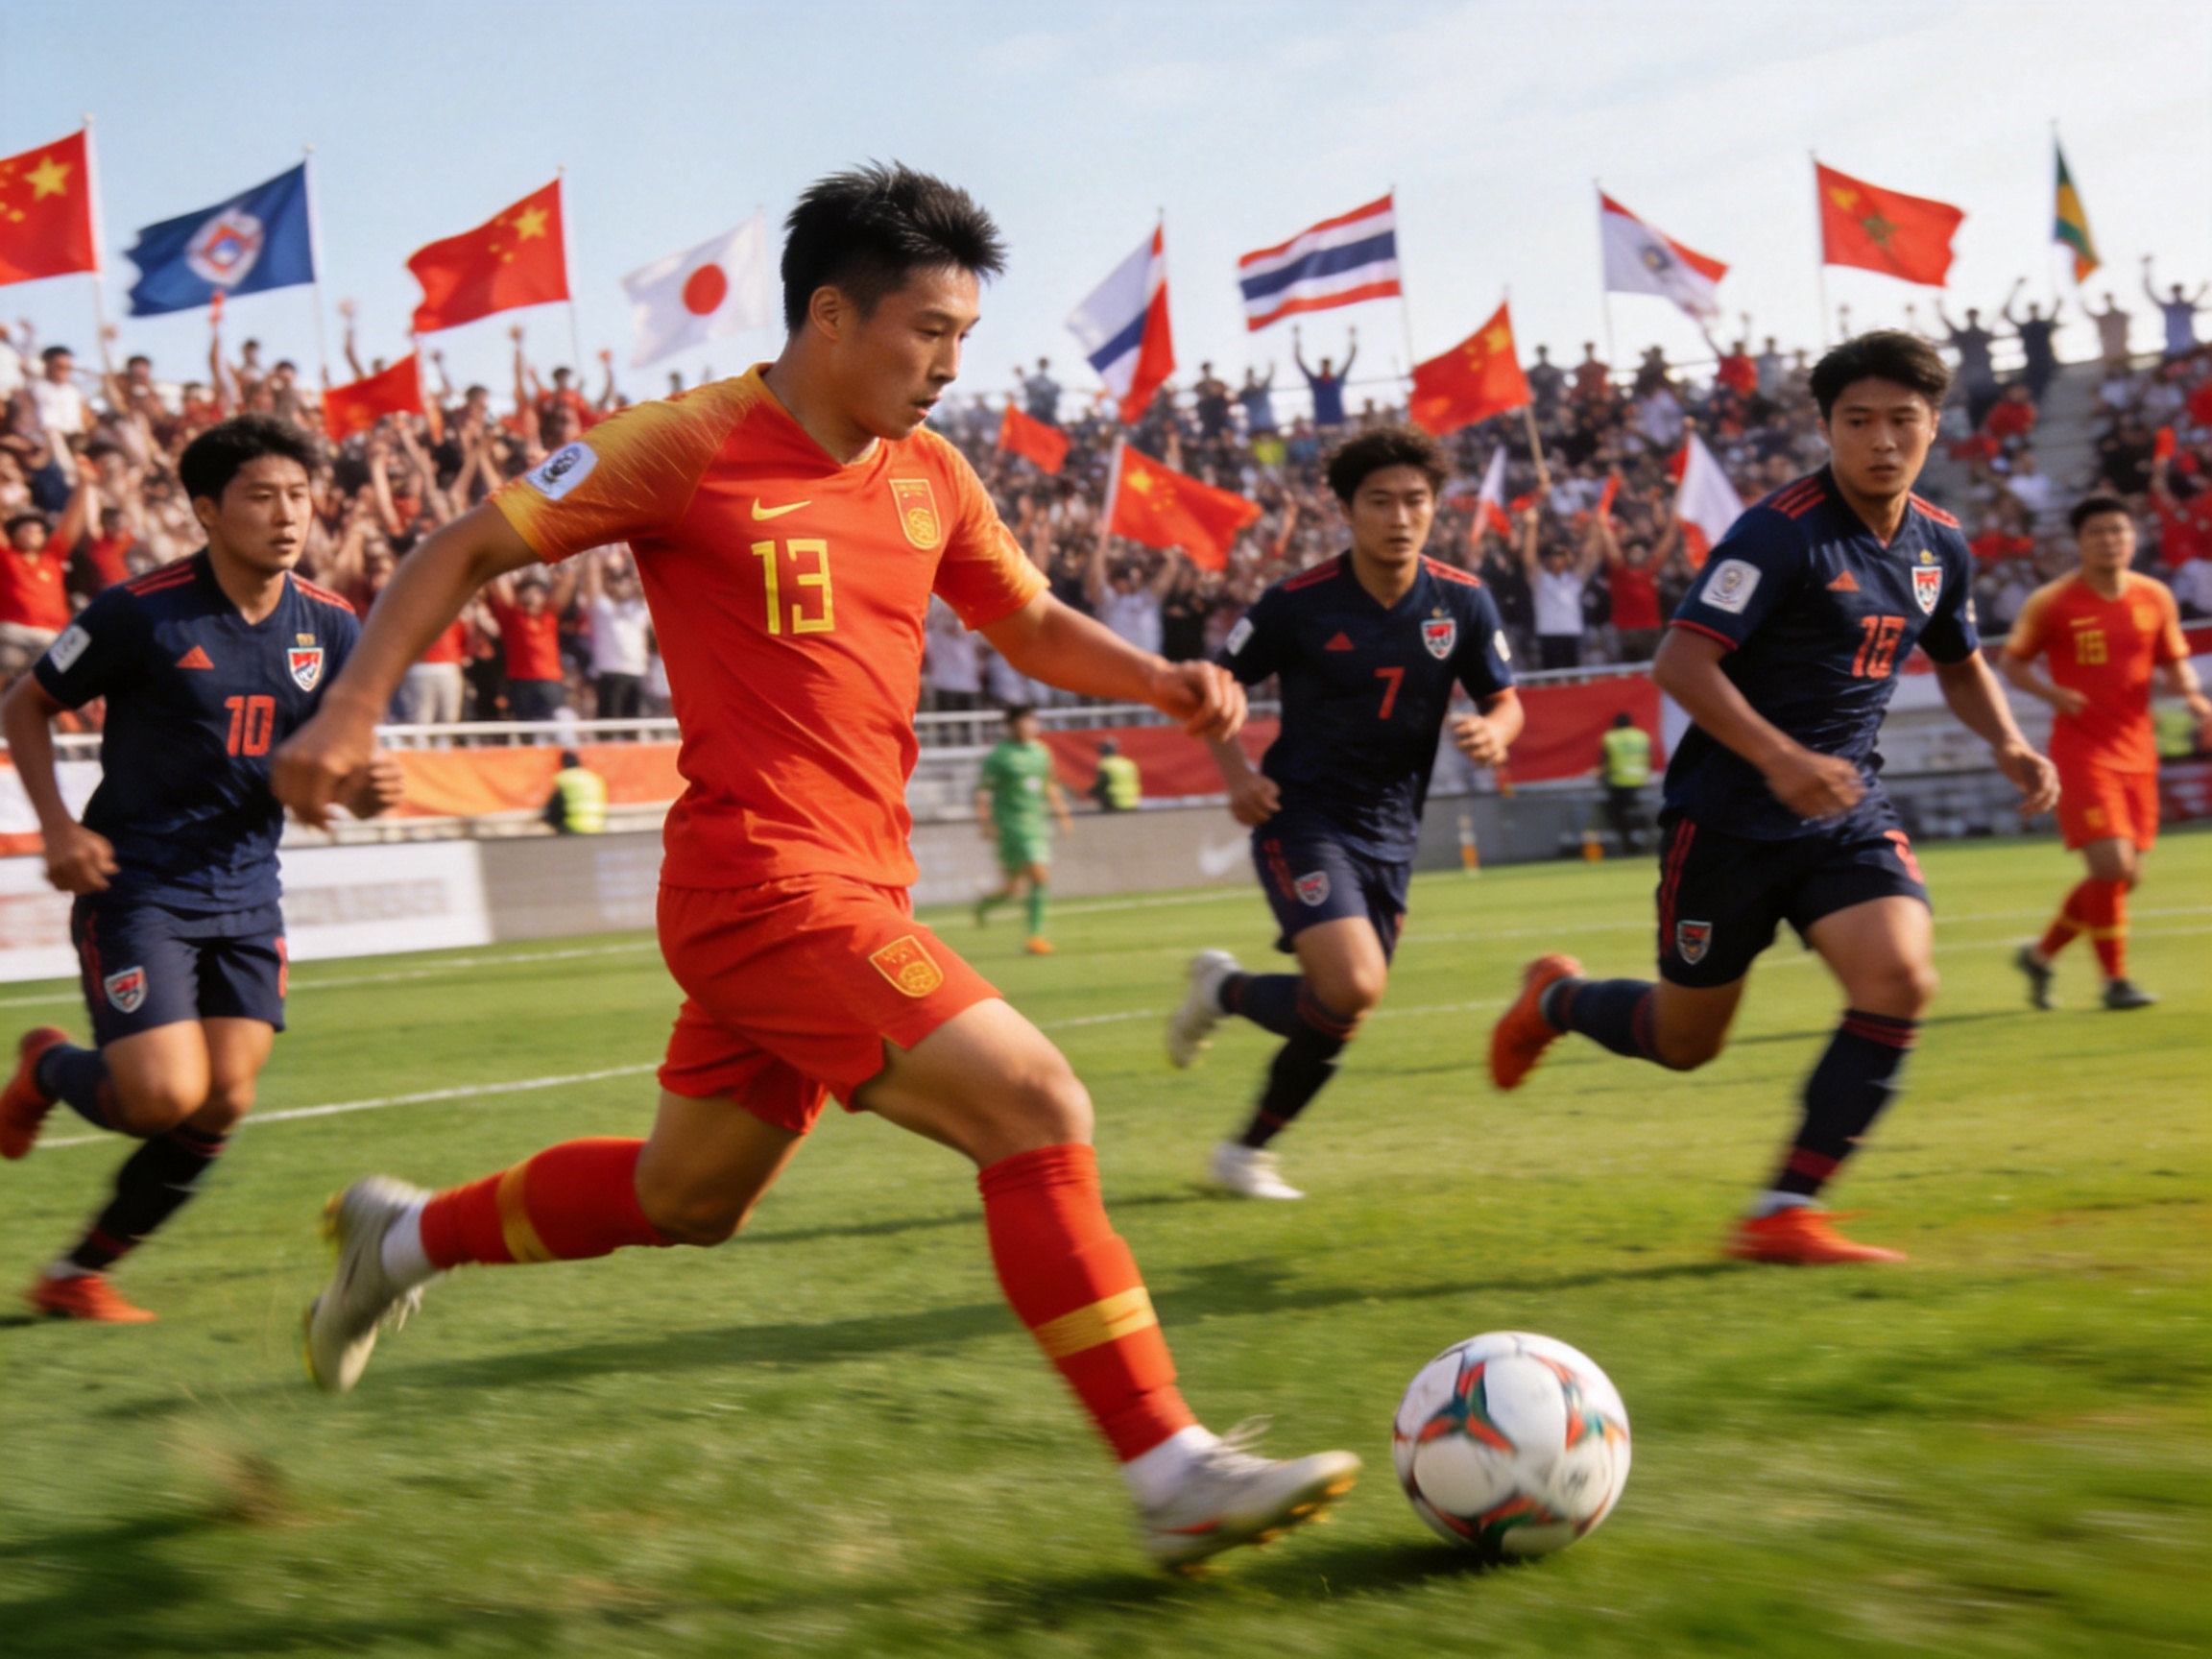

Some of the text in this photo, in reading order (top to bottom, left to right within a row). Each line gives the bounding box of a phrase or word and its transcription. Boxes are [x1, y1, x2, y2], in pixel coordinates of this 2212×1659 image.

[751, 539, 834, 635] 13
[1374, 666, 1405, 720] 7
[224, 695, 276, 757] 10
